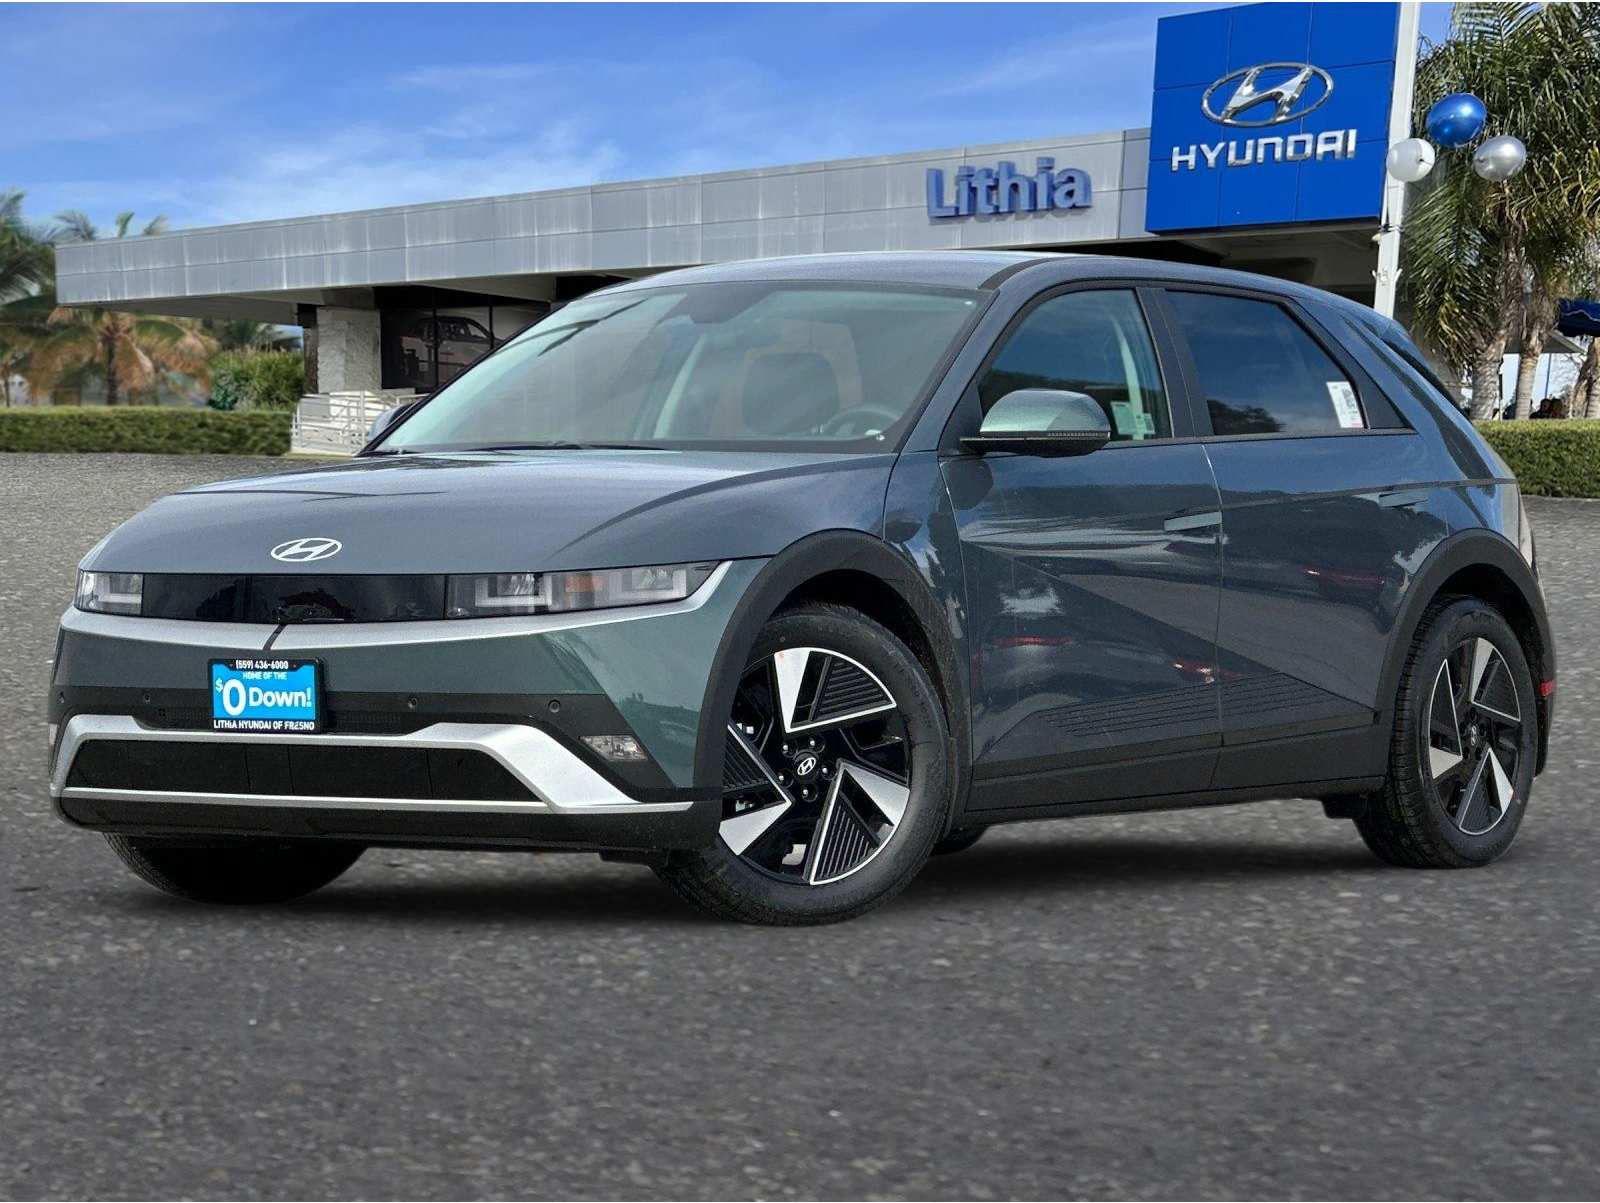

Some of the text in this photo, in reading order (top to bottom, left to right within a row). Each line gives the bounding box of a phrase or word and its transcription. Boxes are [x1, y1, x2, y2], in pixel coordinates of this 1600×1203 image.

[1171, 129, 1357, 172] HYUNDAI
[925, 157, 1092, 219] Lithia
[235, 660, 289, 669] (559) 436-6000
[243, 671, 288, 680] HOME OF THE
[249, 687, 312, 708] Down!
[239, 720, 271, 730] HYUNDAI
[273, 720, 283, 730] OF
[284, 721, 315, 731] FRESNO
